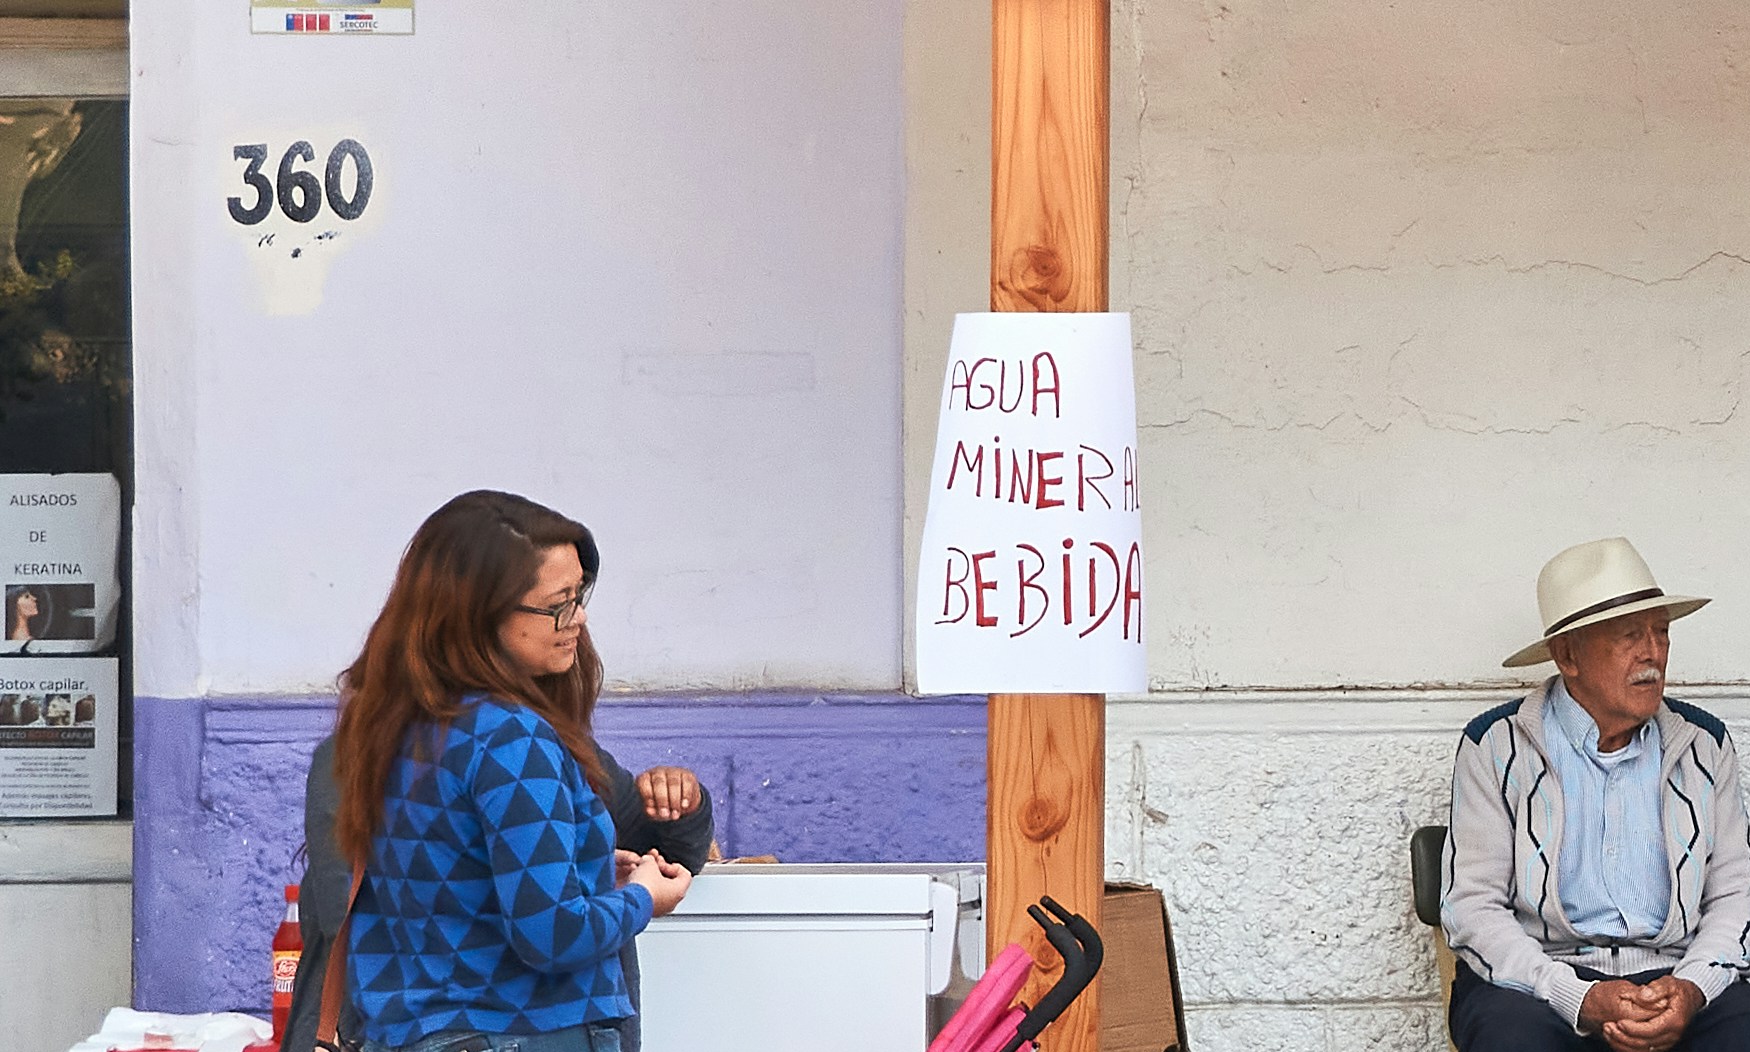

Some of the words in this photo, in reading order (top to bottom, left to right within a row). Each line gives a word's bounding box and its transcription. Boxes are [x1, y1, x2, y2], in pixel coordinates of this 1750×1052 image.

[340, 21, 378, 29] SERCOTEC
[227, 139, 373, 225] 360
[949, 351, 1060, 418] AGUA
[10, 494, 77, 506] ALISADOS
[29, 530, 47, 542] DE
[15, 563, 82, 575] KERATINA
[0, 679, 35, 690] Botox
